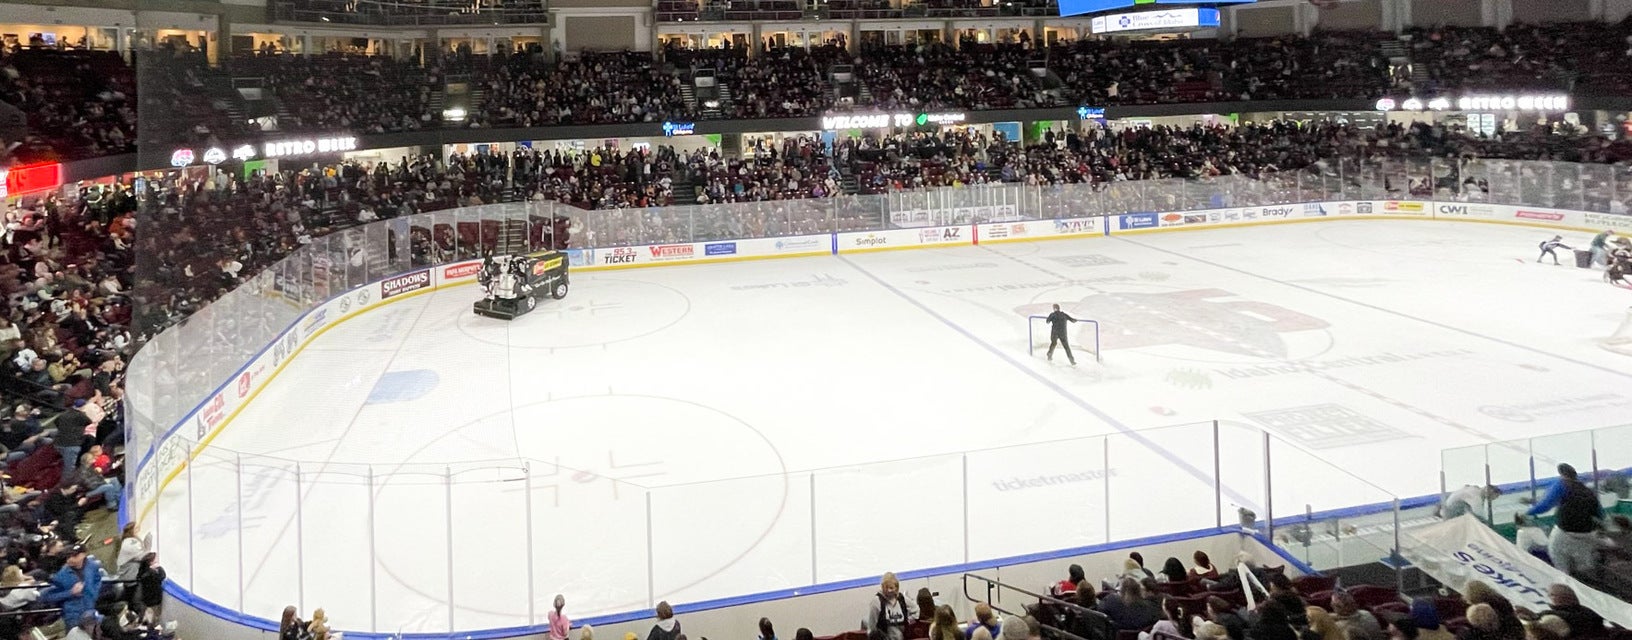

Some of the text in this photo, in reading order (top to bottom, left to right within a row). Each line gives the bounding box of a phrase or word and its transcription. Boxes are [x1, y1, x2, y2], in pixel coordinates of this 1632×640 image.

[823, 113, 890, 129] WELCOME
[894, 113, 913, 127] TO
[266, 137, 357, 157] RETRO WEEK
[1262, 208, 1289, 217] Brady
[1440, 205, 1468, 214] CWI
[944, 228, 960, 238] AZ
[856, 236, 886, 246] Simplot
[613, 247, 632, 256] 95.3
[649, 244, 694, 257] WESTERN
[604, 254, 637, 264] TICKET
[384, 272, 428, 292] SHADOWS
[992, 468, 1118, 491] ticketmaster
